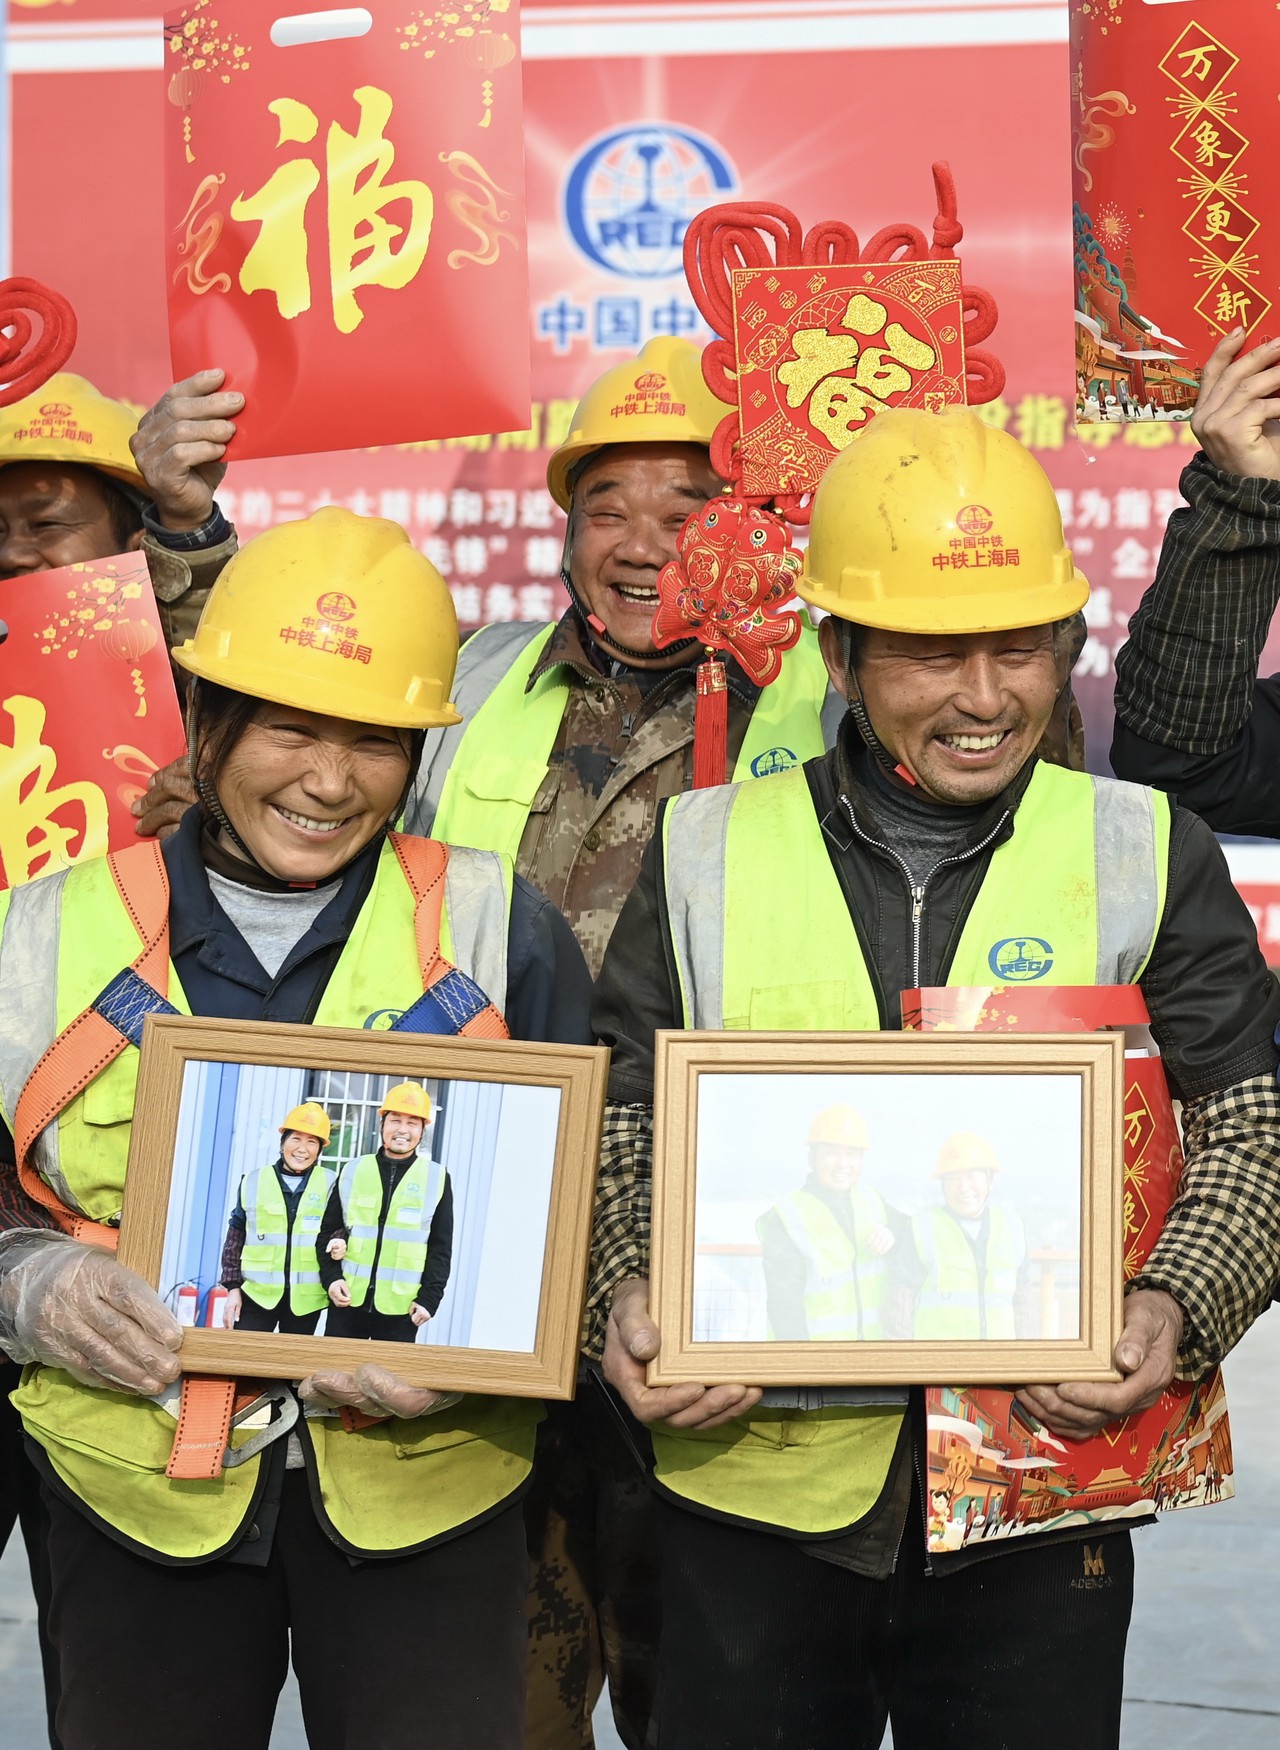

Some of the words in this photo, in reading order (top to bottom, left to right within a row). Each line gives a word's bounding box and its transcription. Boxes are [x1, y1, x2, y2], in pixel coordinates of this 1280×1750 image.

[1178, 44, 1251, 327] 万象更新
[230, 85, 434, 335] 福
[625, 391, 672, 403] 中国中铁
[610, 401, 686, 419] 中铁上海局
[13, 426, 94, 445] 中铁上海局
[949, 535, 1003, 551] 中国中铁
[932, 548, 1020, 571] 中铁上海局
[302, 616, 360, 641] 中国中铁
[279, 626, 373, 665] 中铁上海局
